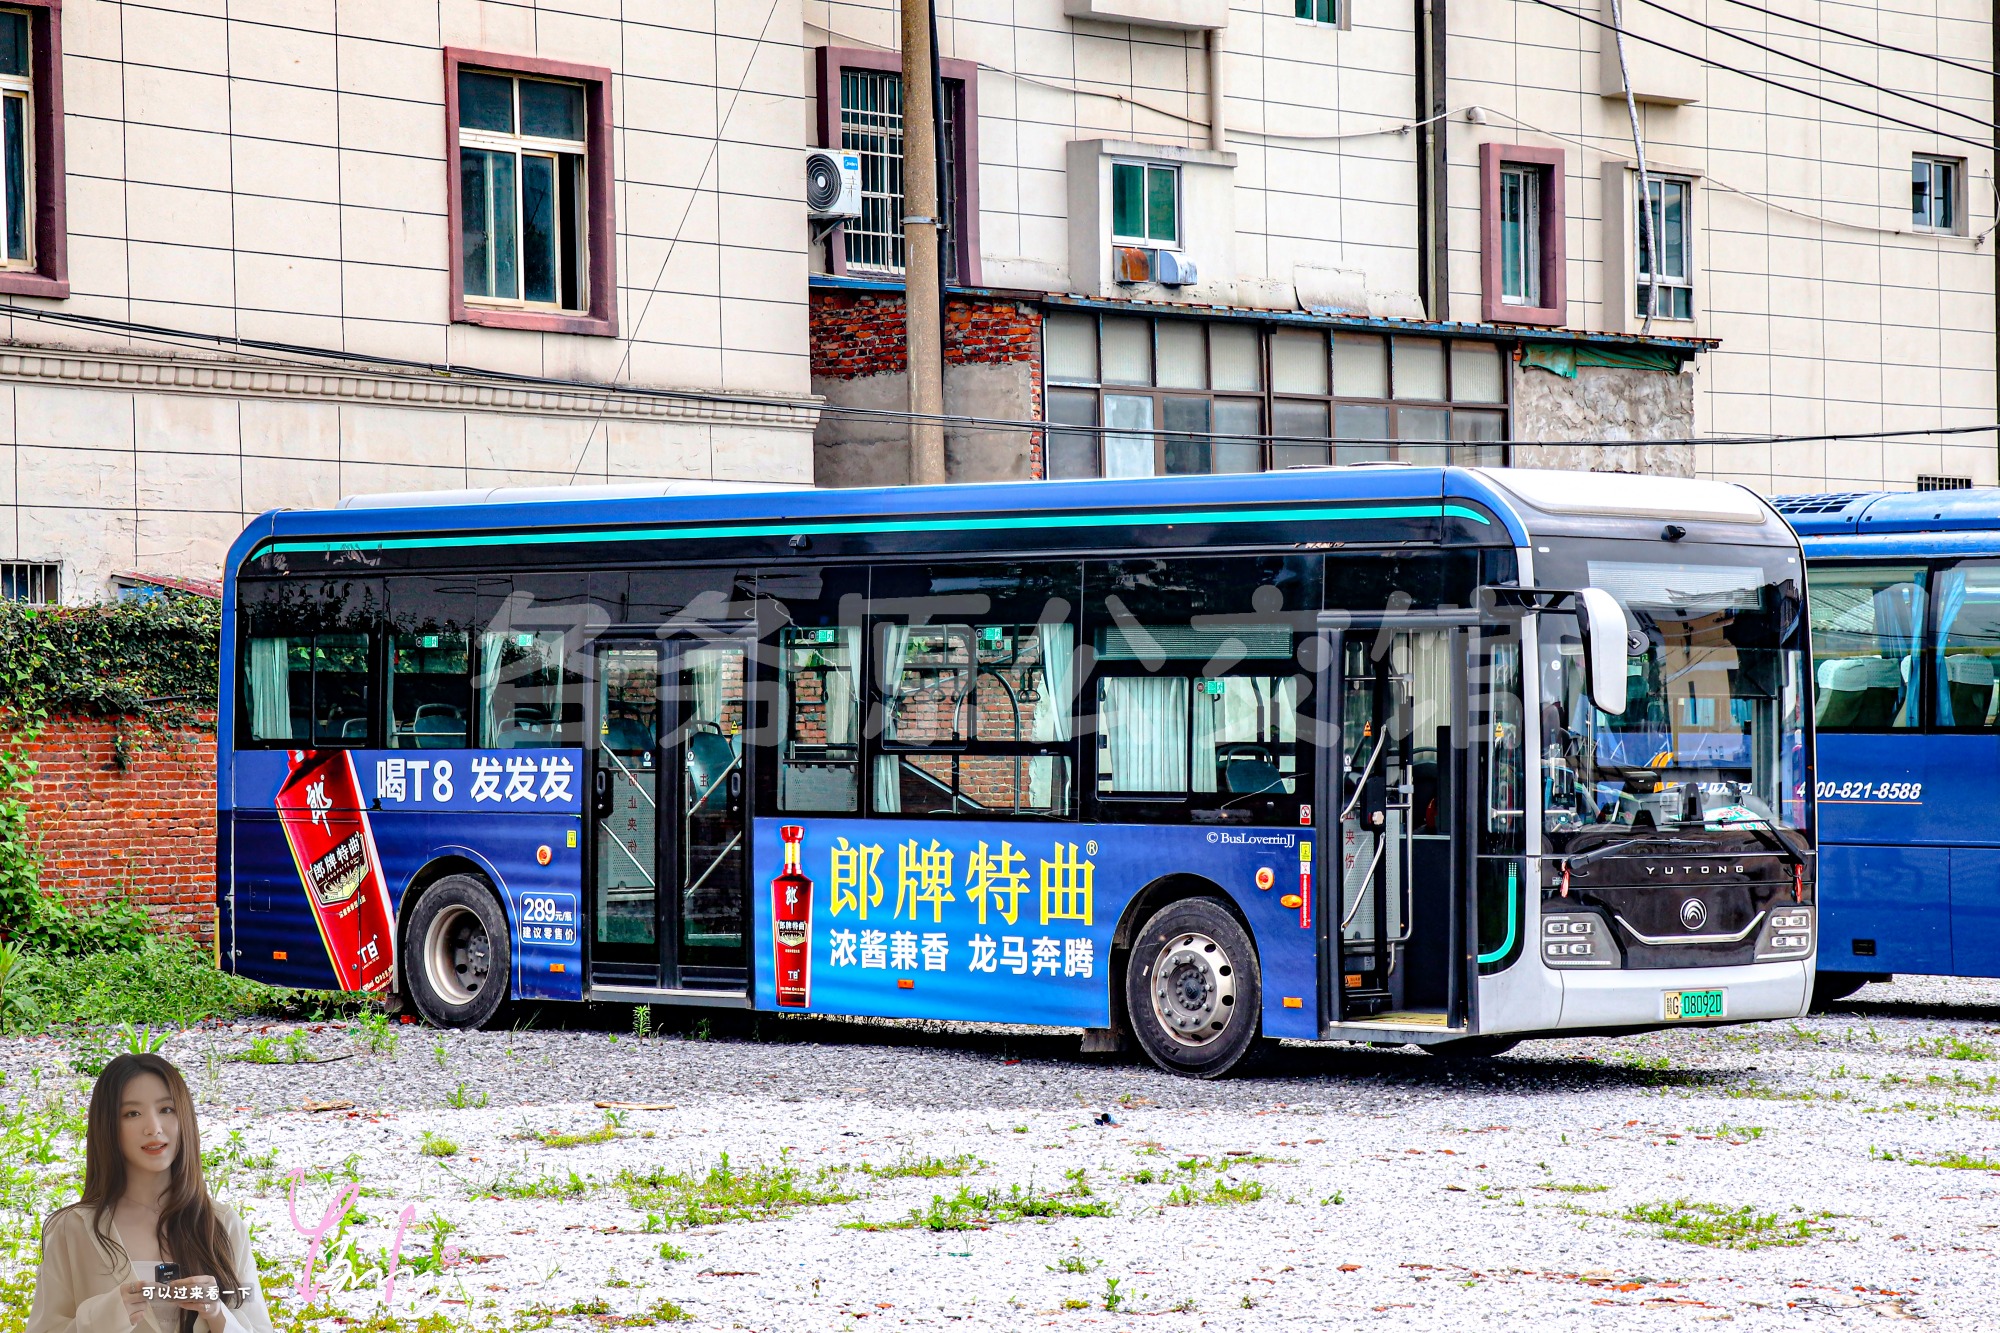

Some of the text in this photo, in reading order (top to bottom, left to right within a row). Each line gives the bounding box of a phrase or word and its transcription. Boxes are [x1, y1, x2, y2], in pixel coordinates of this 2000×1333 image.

[377, 756, 573, 802] 喝T8 发发发
[313, 836, 360, 881] 郎牌特曲
[829, 837, 1096, 925] 郎牌特曲
[1646, 866, 1744, 874] YUTONG
[523, 926, 573, 940] 建议零售价
[829, 929, 1094, 979] 浓酱兼香 龙马奔腾
